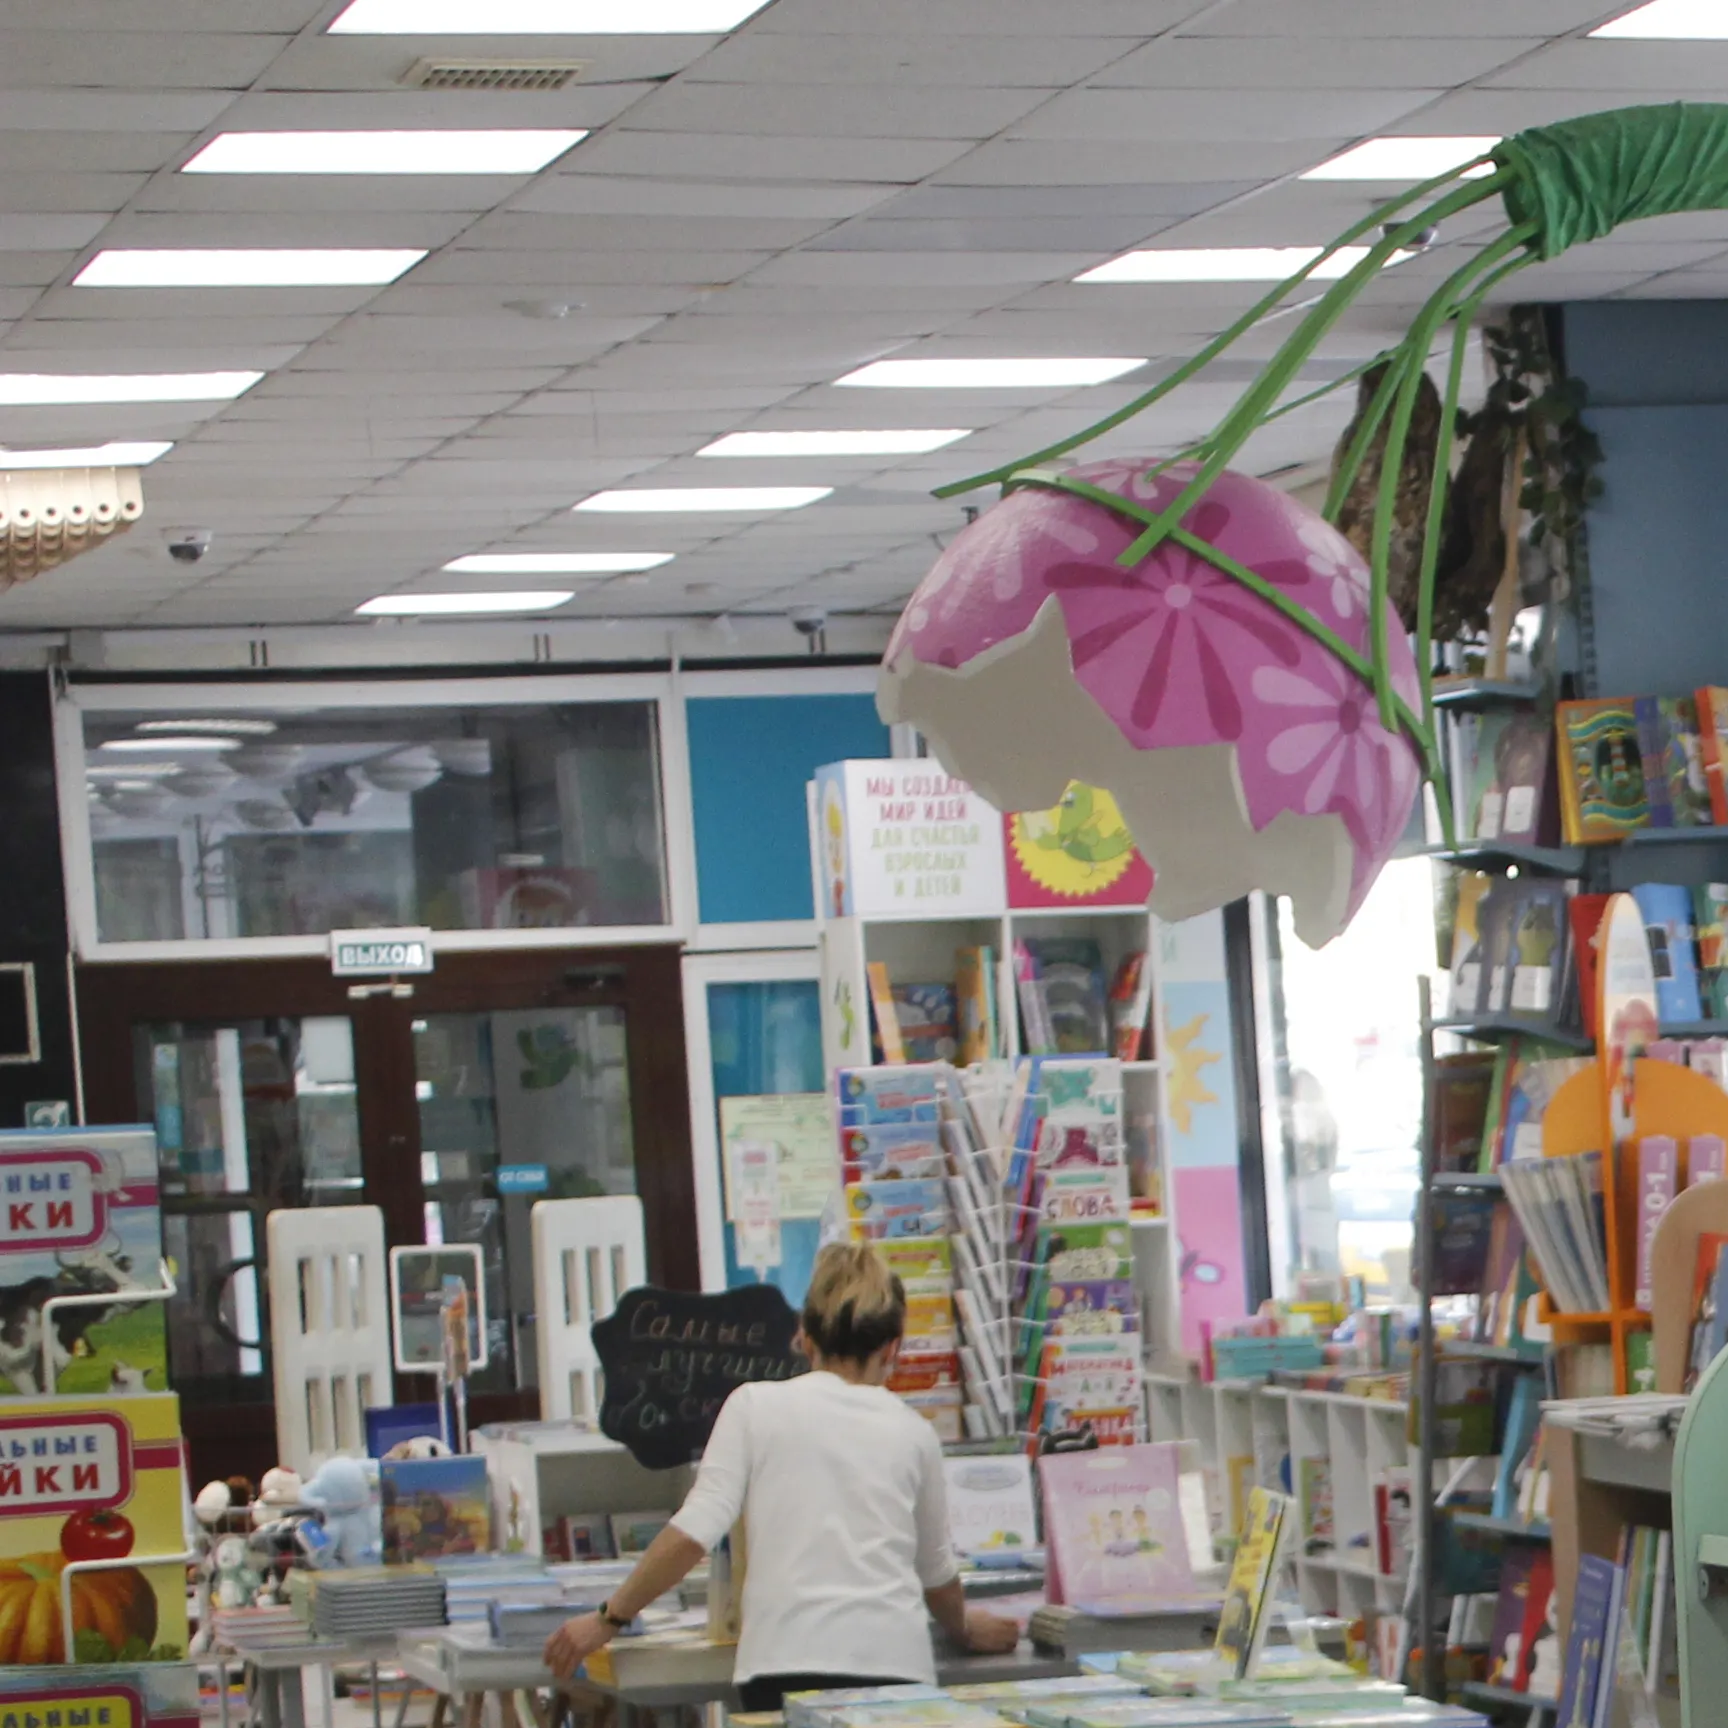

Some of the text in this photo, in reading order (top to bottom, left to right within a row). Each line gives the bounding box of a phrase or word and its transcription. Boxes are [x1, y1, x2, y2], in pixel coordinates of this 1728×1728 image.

[880, 798, 968, 822] МИР ИДЕЙ
[341, 944, 424, 967] ВЫХОД
[9, 1200, 74, 1231] КИ
[0, 1462, 101, 1497] ЙКИ
